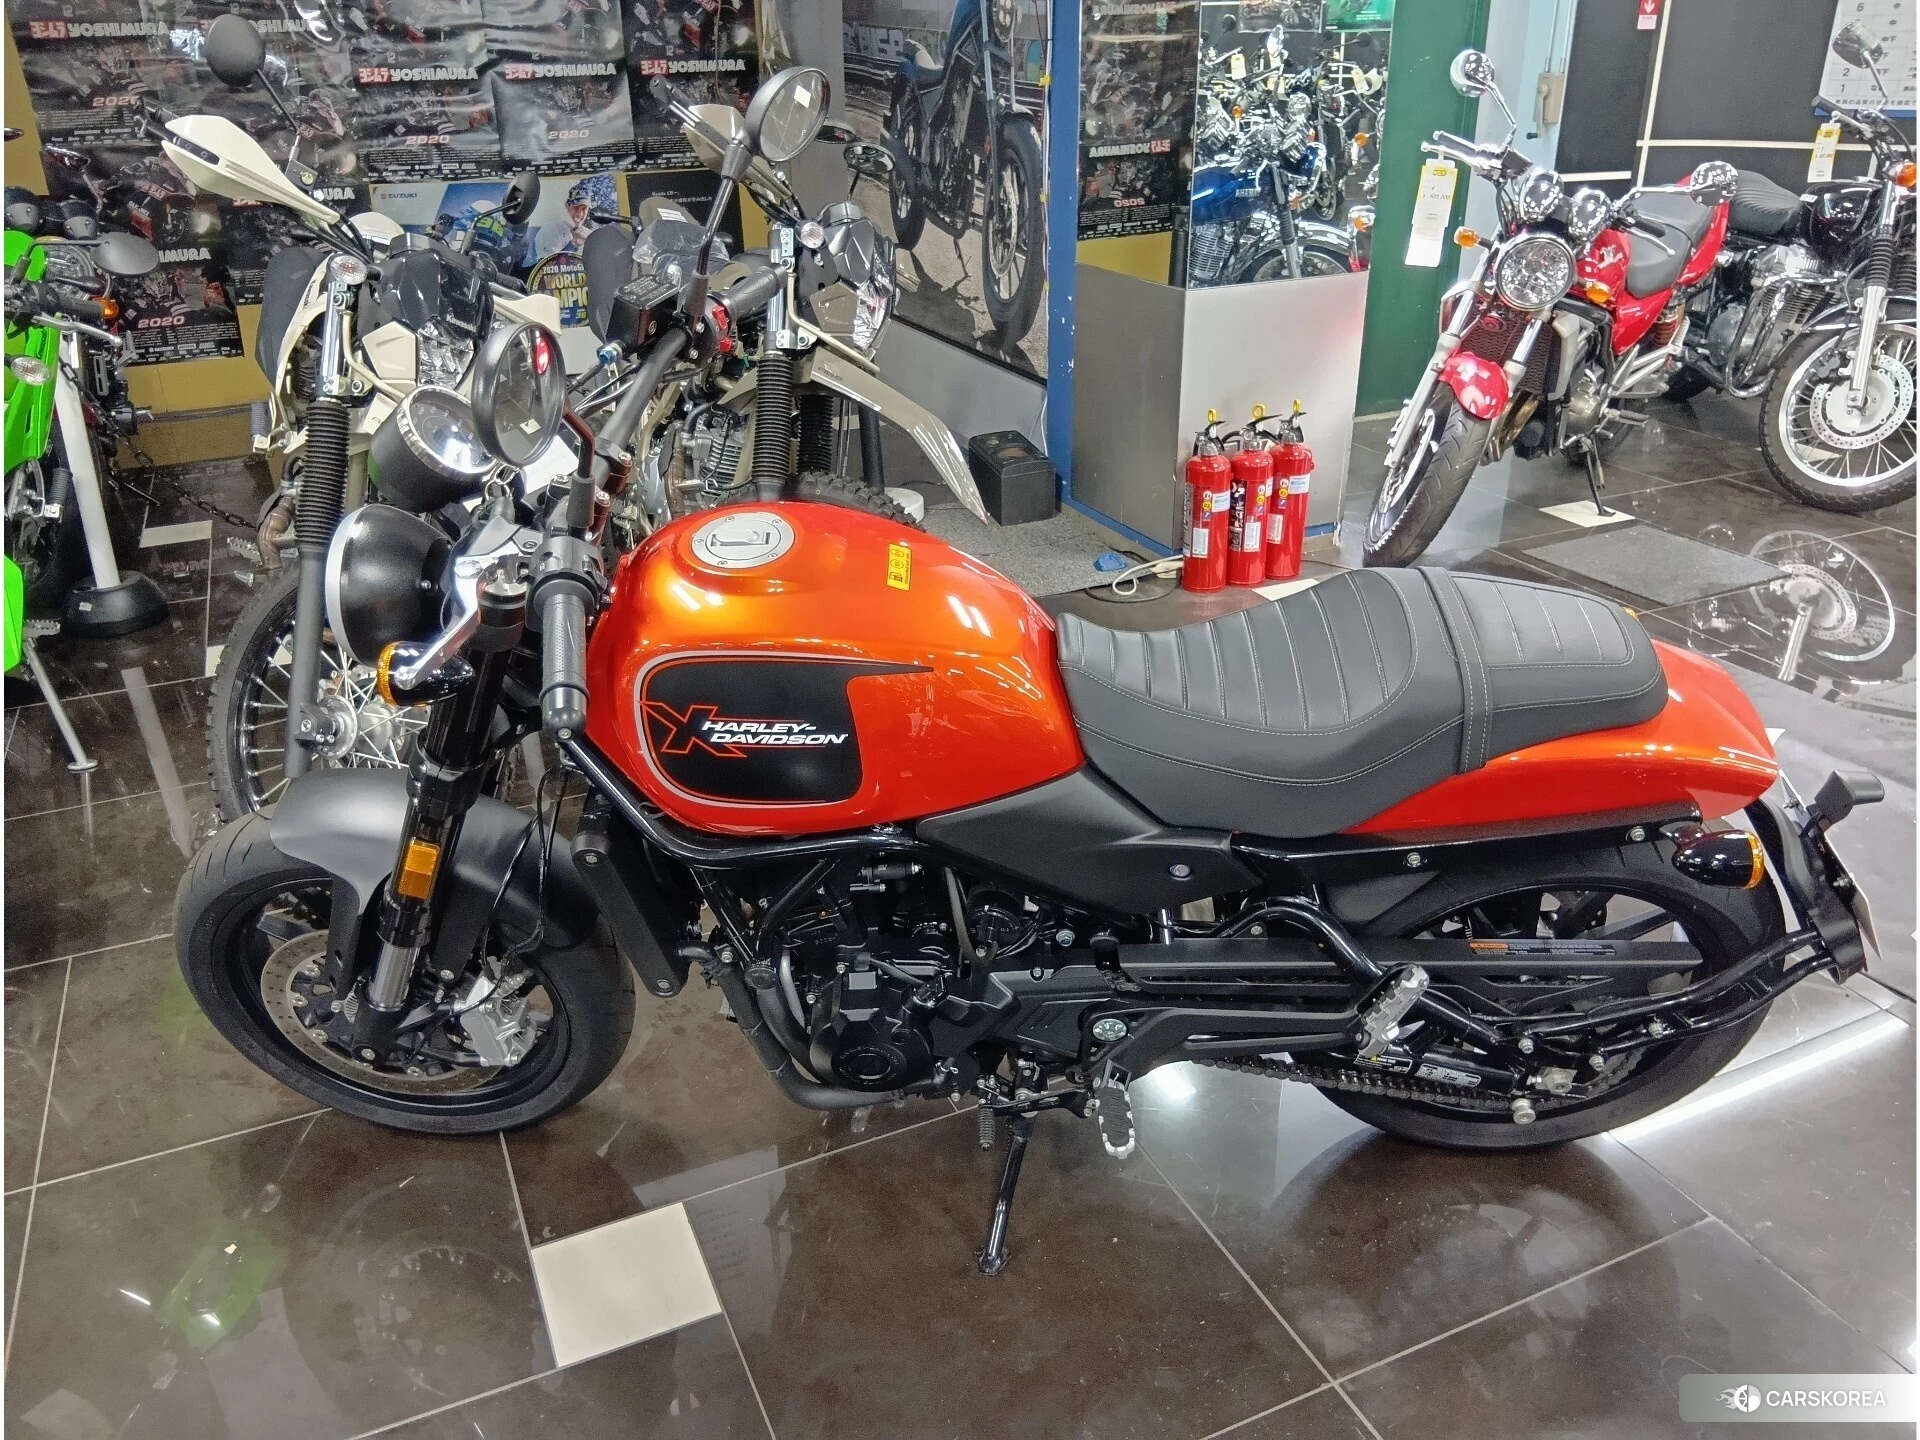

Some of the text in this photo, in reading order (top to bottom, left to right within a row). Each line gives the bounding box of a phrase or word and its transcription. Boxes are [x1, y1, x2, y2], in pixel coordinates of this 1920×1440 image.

[67, 21, 169, 37] YOSHIMURA
[533, 63, 617, 78] YOSHIMURA
[668, 59, 746, 73] YOSHIMURA
[1843, 68, 1850, 76] 2
[389, 67, 478, 81] YOSHIMURA
[405, 135, 450, 145] 2020
[548, 129, 590, 139] 2020
[543, 265, 559, 274] 2020
[544, 273, 587, 289] WORLD
[138, 315, 185, 328] 2020
[701, 721, 817, 733] HARLEY-
[710, 733, 848, 745] DAVIDSON
